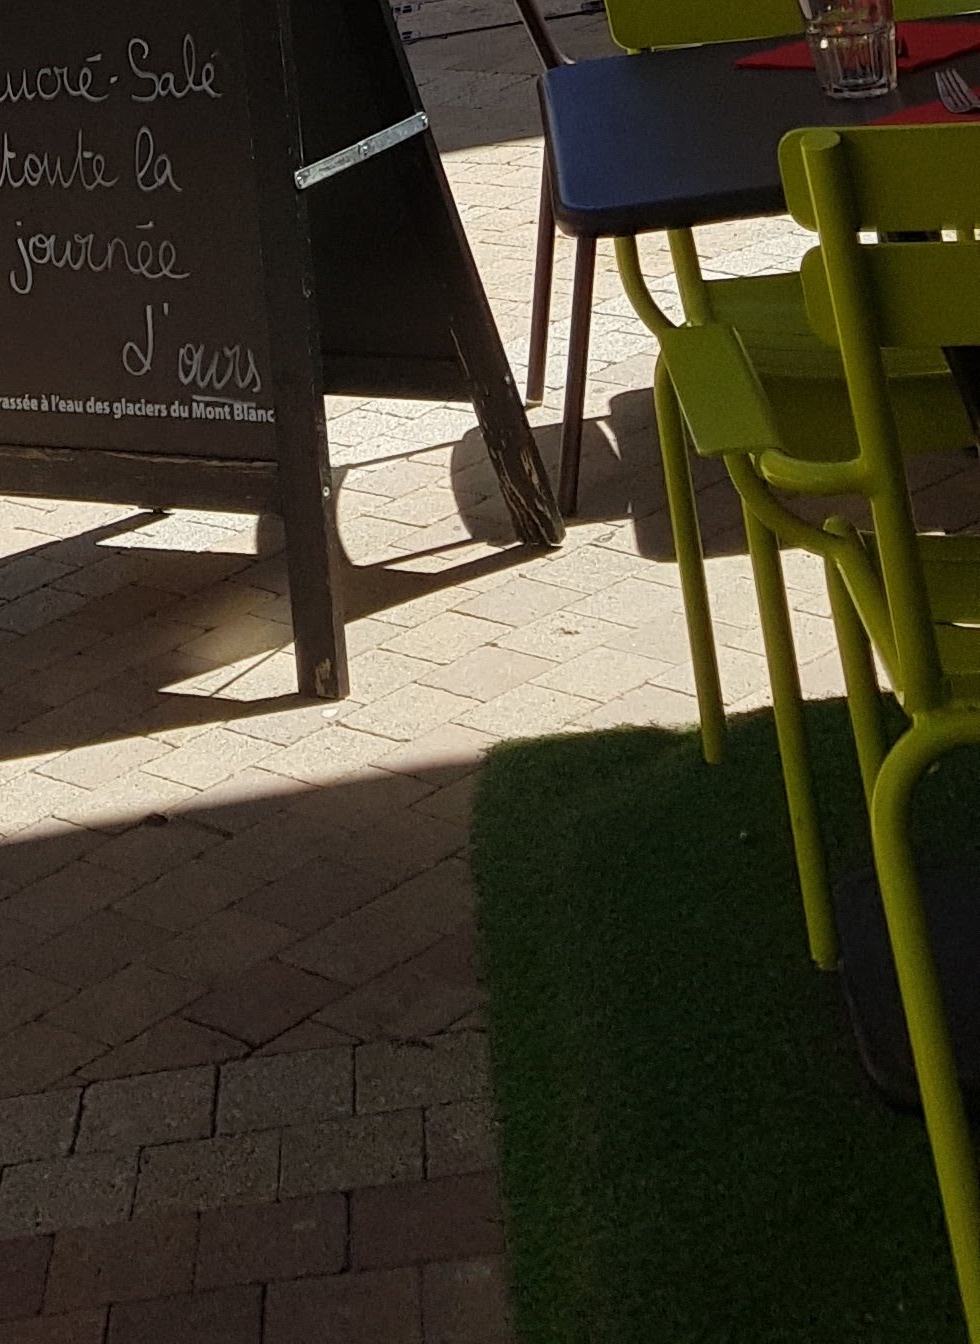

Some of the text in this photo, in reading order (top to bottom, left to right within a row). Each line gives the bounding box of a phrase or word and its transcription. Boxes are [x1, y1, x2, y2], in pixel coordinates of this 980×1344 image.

[135, 125, 183, 192] la
[10, 220, 191, 295] journée
[41, 394, 49, 411] à
[51, 394, 84, 413] l'eau
[86, 397, 110, 414] des
[112, 398, 168, 419] glaciers
[170, 400, 190, 418] du
[192, 401, 231, 420] Mont
[233, 403, 276, 423] Blanc
